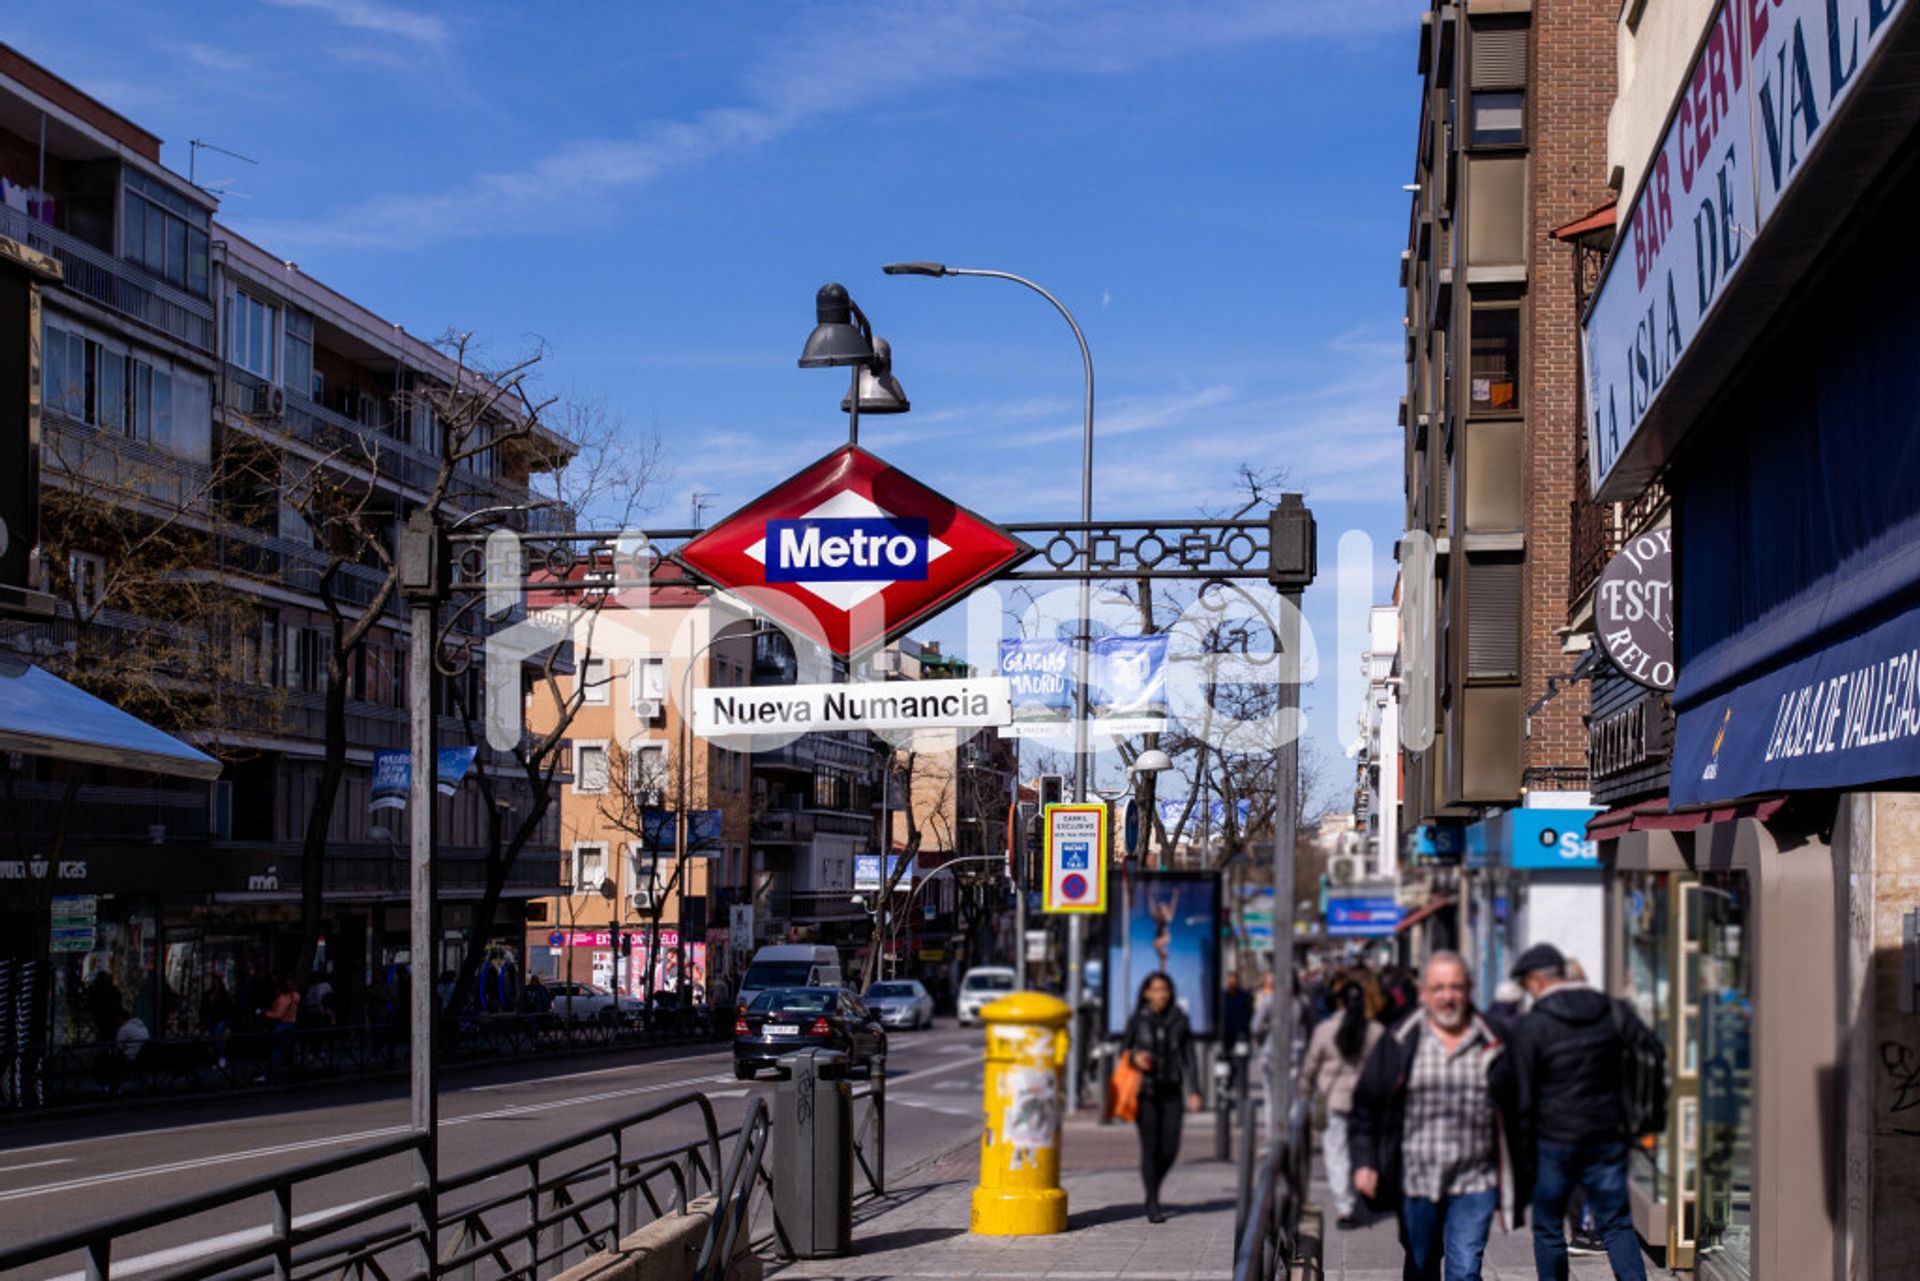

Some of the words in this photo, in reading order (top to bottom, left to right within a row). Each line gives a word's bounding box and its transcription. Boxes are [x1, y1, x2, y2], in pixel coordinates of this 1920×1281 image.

[1632, 151, 1673, 293] BAR
[1679, 0, 1780, 195] CERVE
[1593, 382, 1619, 478] LA
[1627, 268, 1683, 431] ISLA
[1692, 143, 1742, 322] DE
[780, 526, 917, 569] Metro
[1602, 578, 1673, 622] EST
[1002, 650, 1067, 673] GRACIAS
[1010, 673, 1065, 696] MADRID
[713, 696, 811, 725] Nueva
[824, 688, 989, 721] Numancia
[1814, 673, 1849, 753] DE
